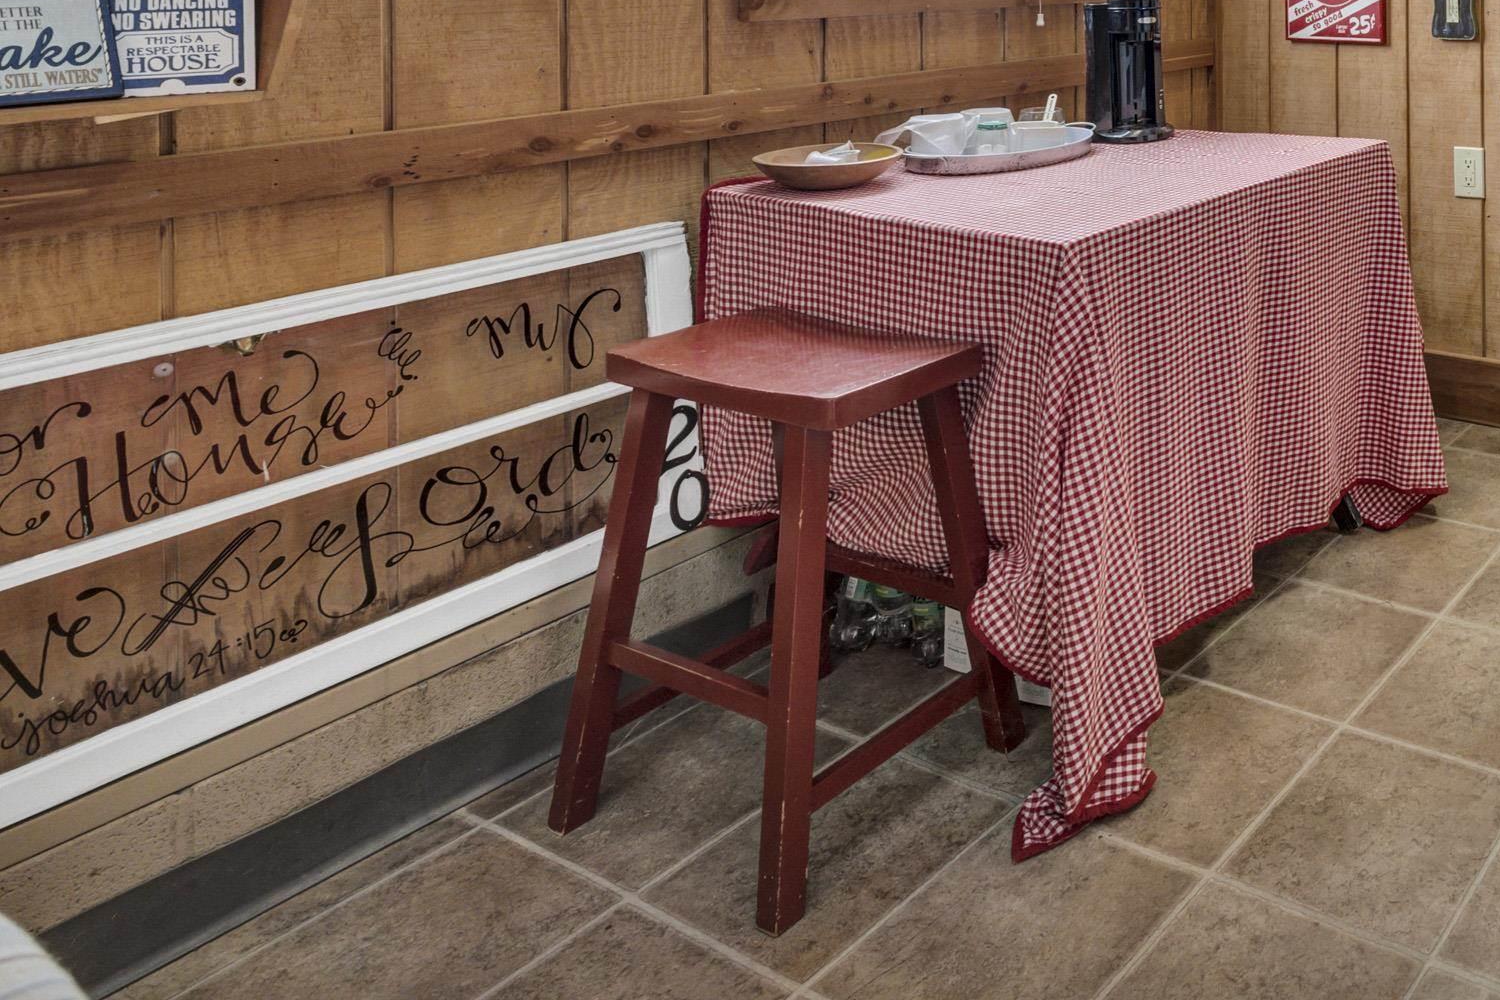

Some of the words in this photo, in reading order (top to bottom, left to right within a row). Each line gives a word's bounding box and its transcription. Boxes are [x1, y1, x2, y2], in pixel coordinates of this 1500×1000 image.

[1293, 1, 1314, 17] fresh
[1304, 7, 1328, 24] crispy
[14, 19, 42, 30] THE
[111, 13, 134, 31] NO
[139, 10, 237, 30] SWEARING
[1312, 20, 1322, 31] so
[1323, 10, 1344, 27] good
[1349, 14, 1376, 36] 25¢
[126, 44, 221, 57] RESPECTABLE
[145, 36, 177, 45] THIS
[179, 36, 192, 44] IS
[195, 35, 204, 43] A
[126, 53, 221, 74] HOUSE
[4, 72, 42, 89] STILL
[141, 350, 320, 437] me
[466, 288, 622, 371] my
[30, 391, 375, 540] House
[318, 413, 612, 619] Lord
[187, 619, 276, 680] 24:15
